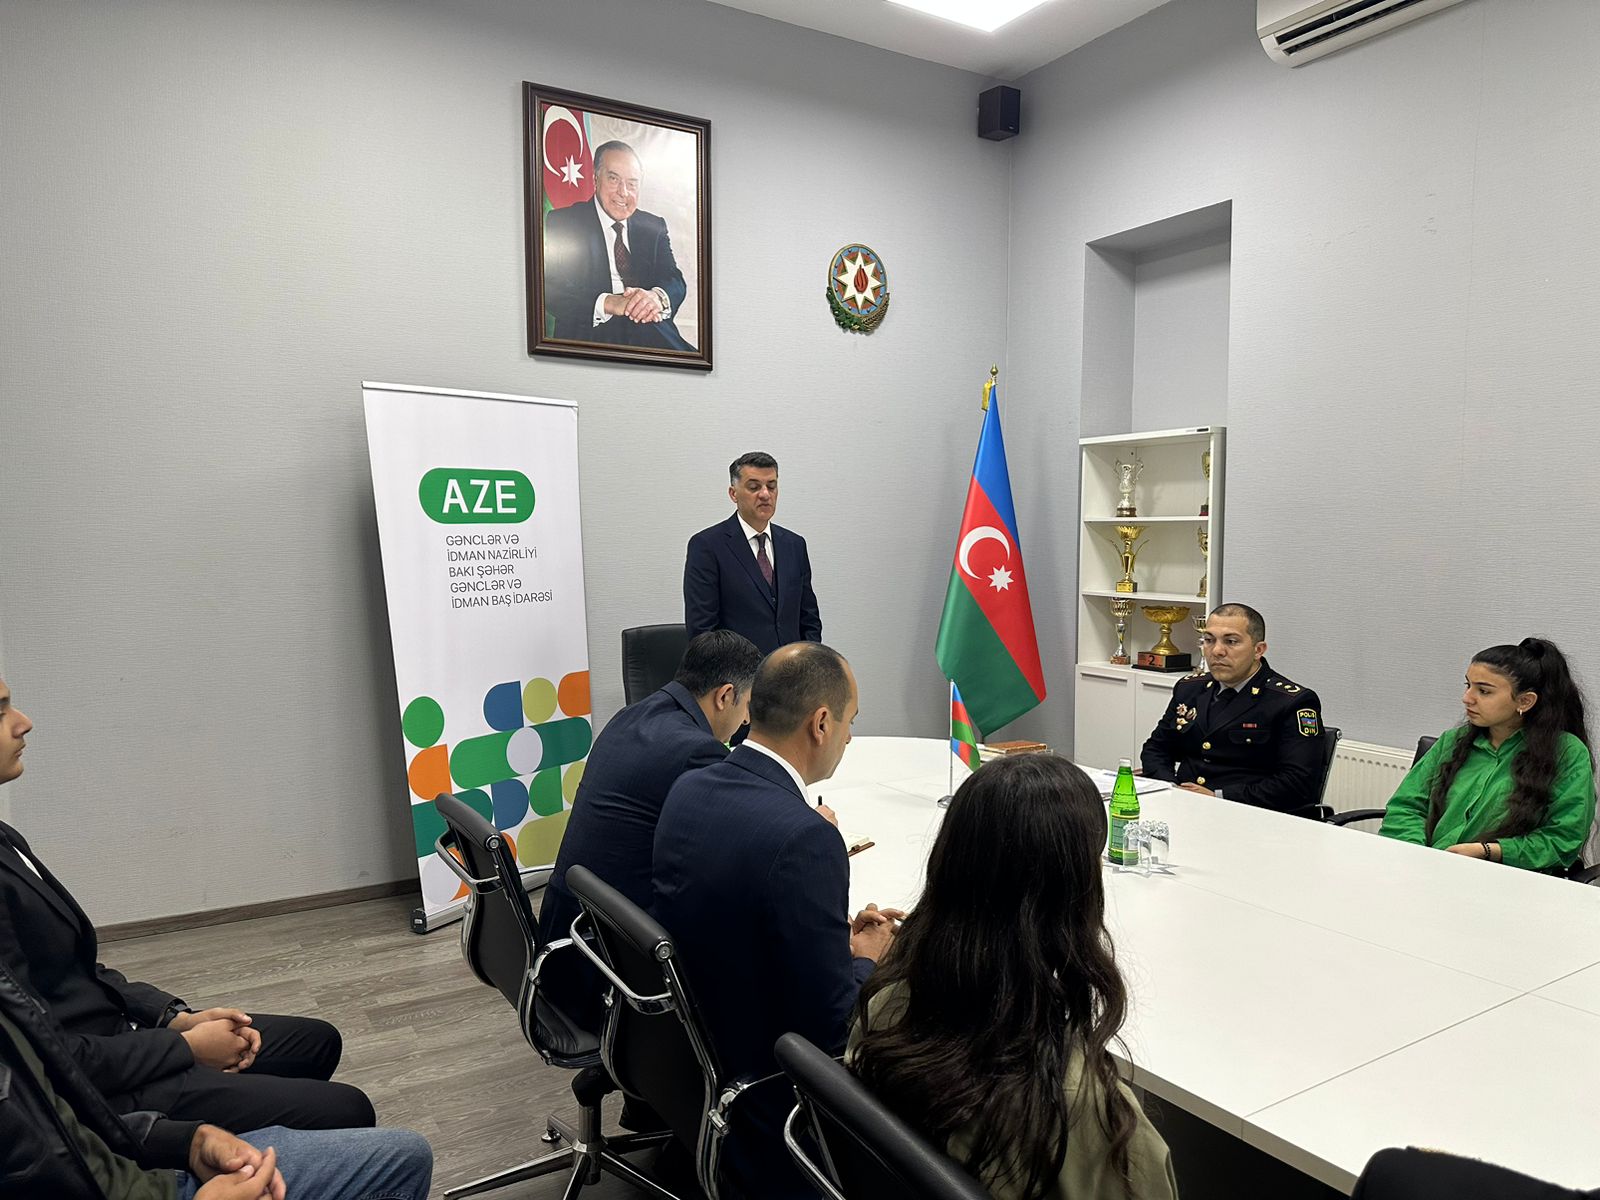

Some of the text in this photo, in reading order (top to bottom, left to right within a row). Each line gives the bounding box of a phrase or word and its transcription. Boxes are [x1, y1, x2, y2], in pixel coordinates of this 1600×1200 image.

[442, 478, 517, 514] AZE
[446, 534, 520, 546] GƏNCLƏR VƏ
[447, 546, 537, 562] İDMAN NAZİRLİYİ
[449, 564, 514, 578] BAKI ŞƏHƏR
[450, 578, 522, 593] GƏNCLƏR VƏ
[451, 589, 553, 608] İDMAN BAŞ İDARƏSİ
[1148, 655, 1155, 666] 2
